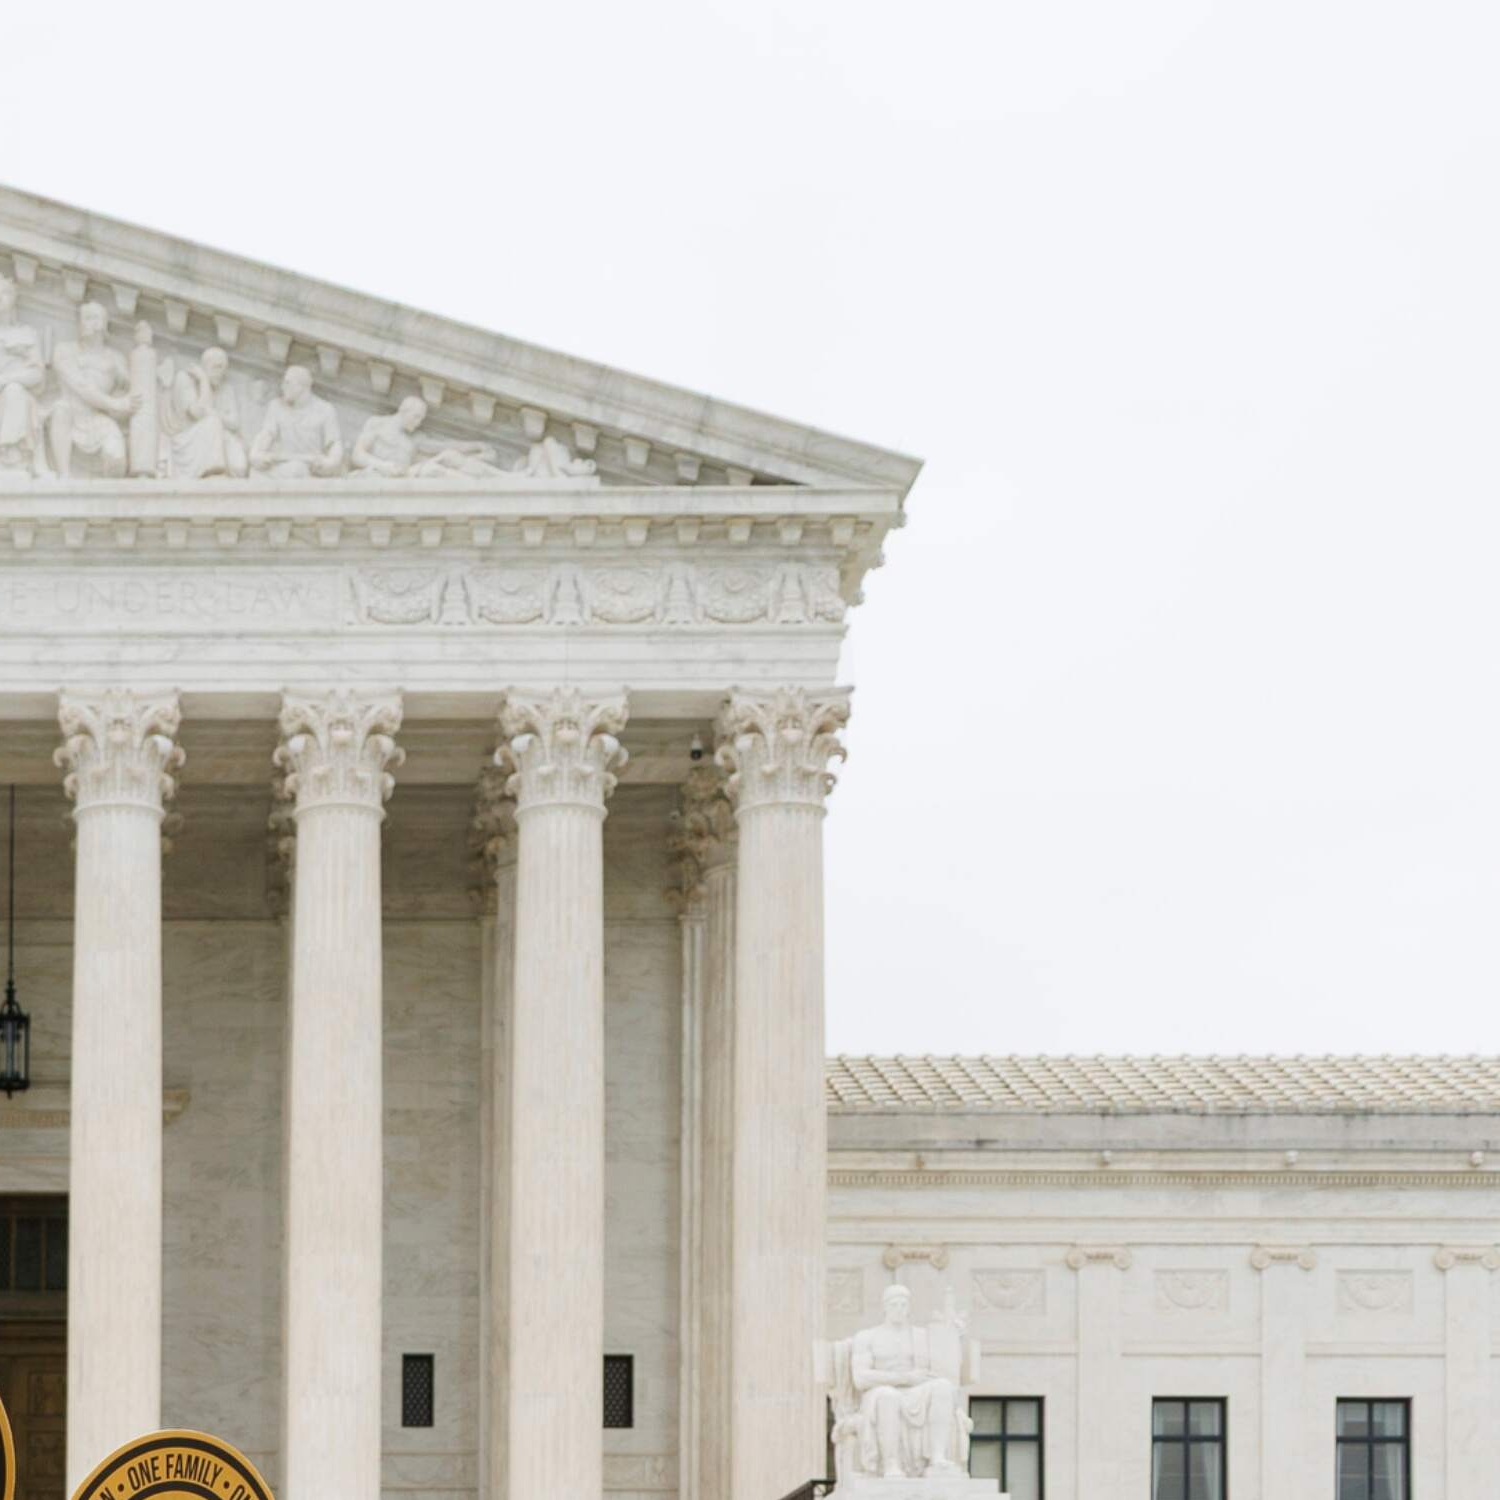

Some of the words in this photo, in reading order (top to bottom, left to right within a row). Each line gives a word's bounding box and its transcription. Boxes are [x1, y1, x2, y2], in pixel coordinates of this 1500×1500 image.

[53, 580, 201, 615] UNDER
[225, 580, 314, 615] LAW
[127, 1455, 162, 1491] ONE
[165, 1453, 224, 1489] FAMILY
